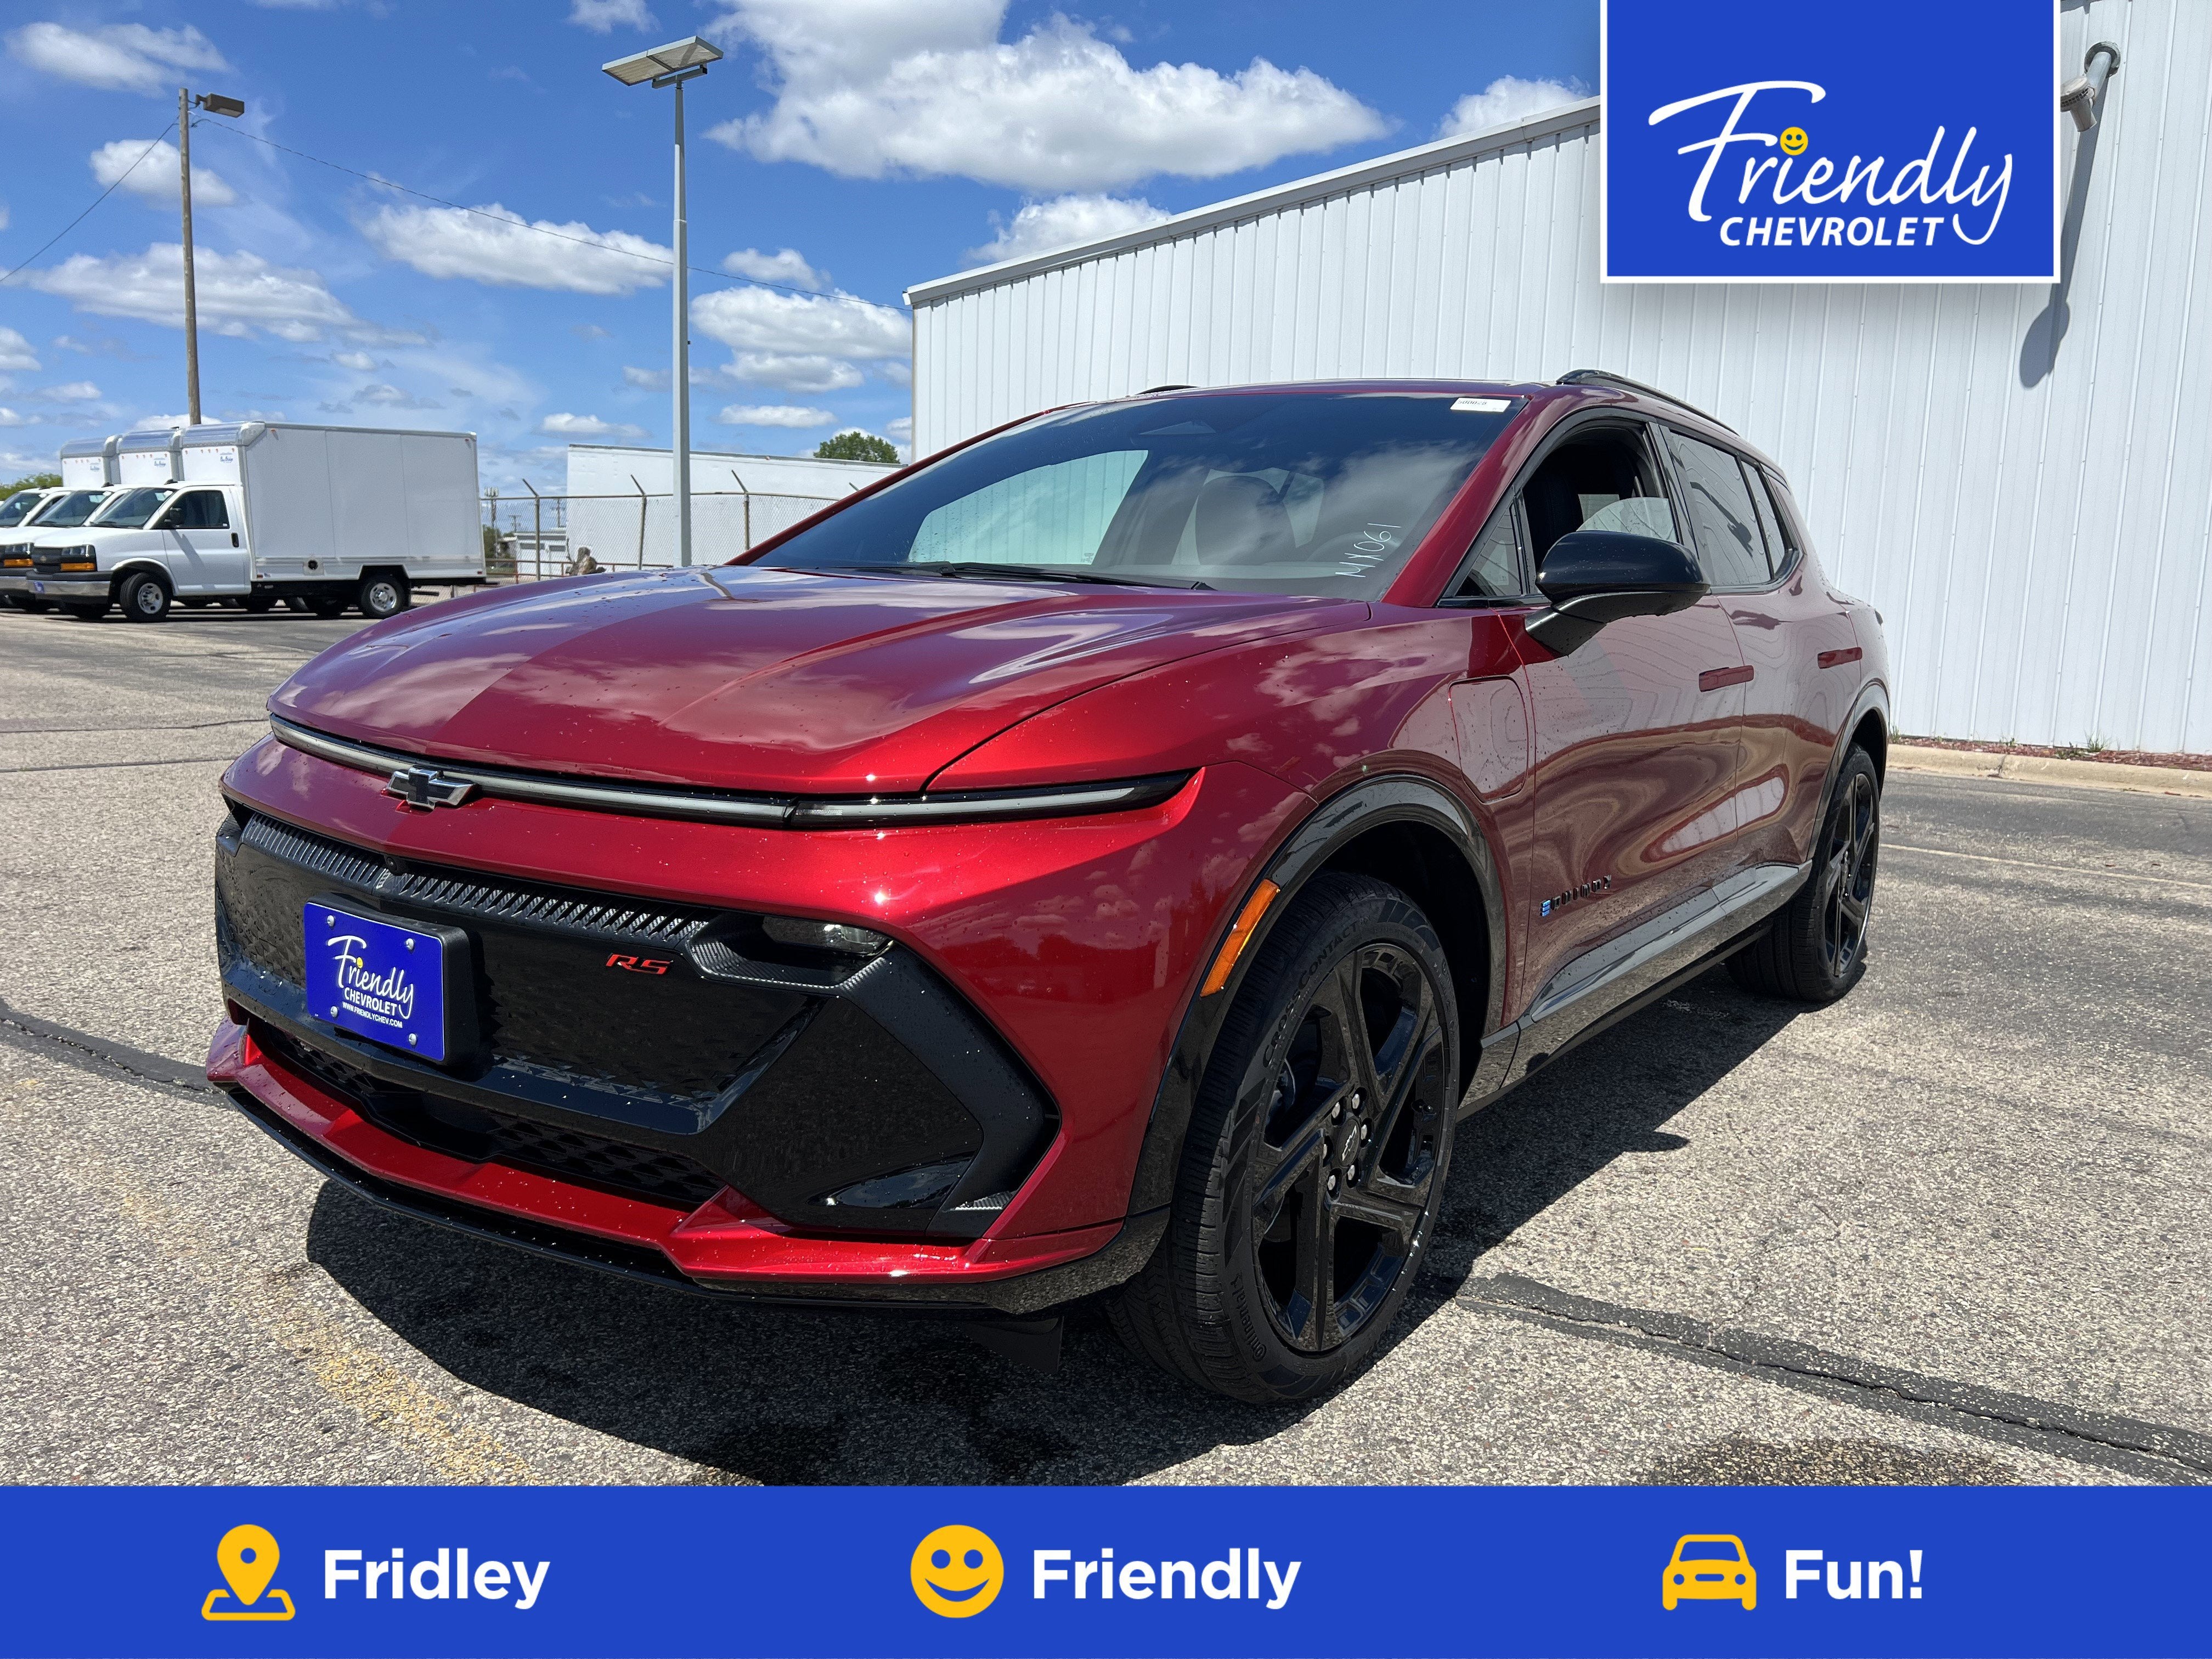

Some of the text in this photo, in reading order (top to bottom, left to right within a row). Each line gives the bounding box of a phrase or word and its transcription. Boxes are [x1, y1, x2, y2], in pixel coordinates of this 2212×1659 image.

[328, 935, 414, 1019] Friendly
[605, 953, 672, 974] RS
[342, 1001, 403, 1028] WWW.FRIENDLYCHEV.COM
[345, 987, 397, 1016] CHEVROLET
